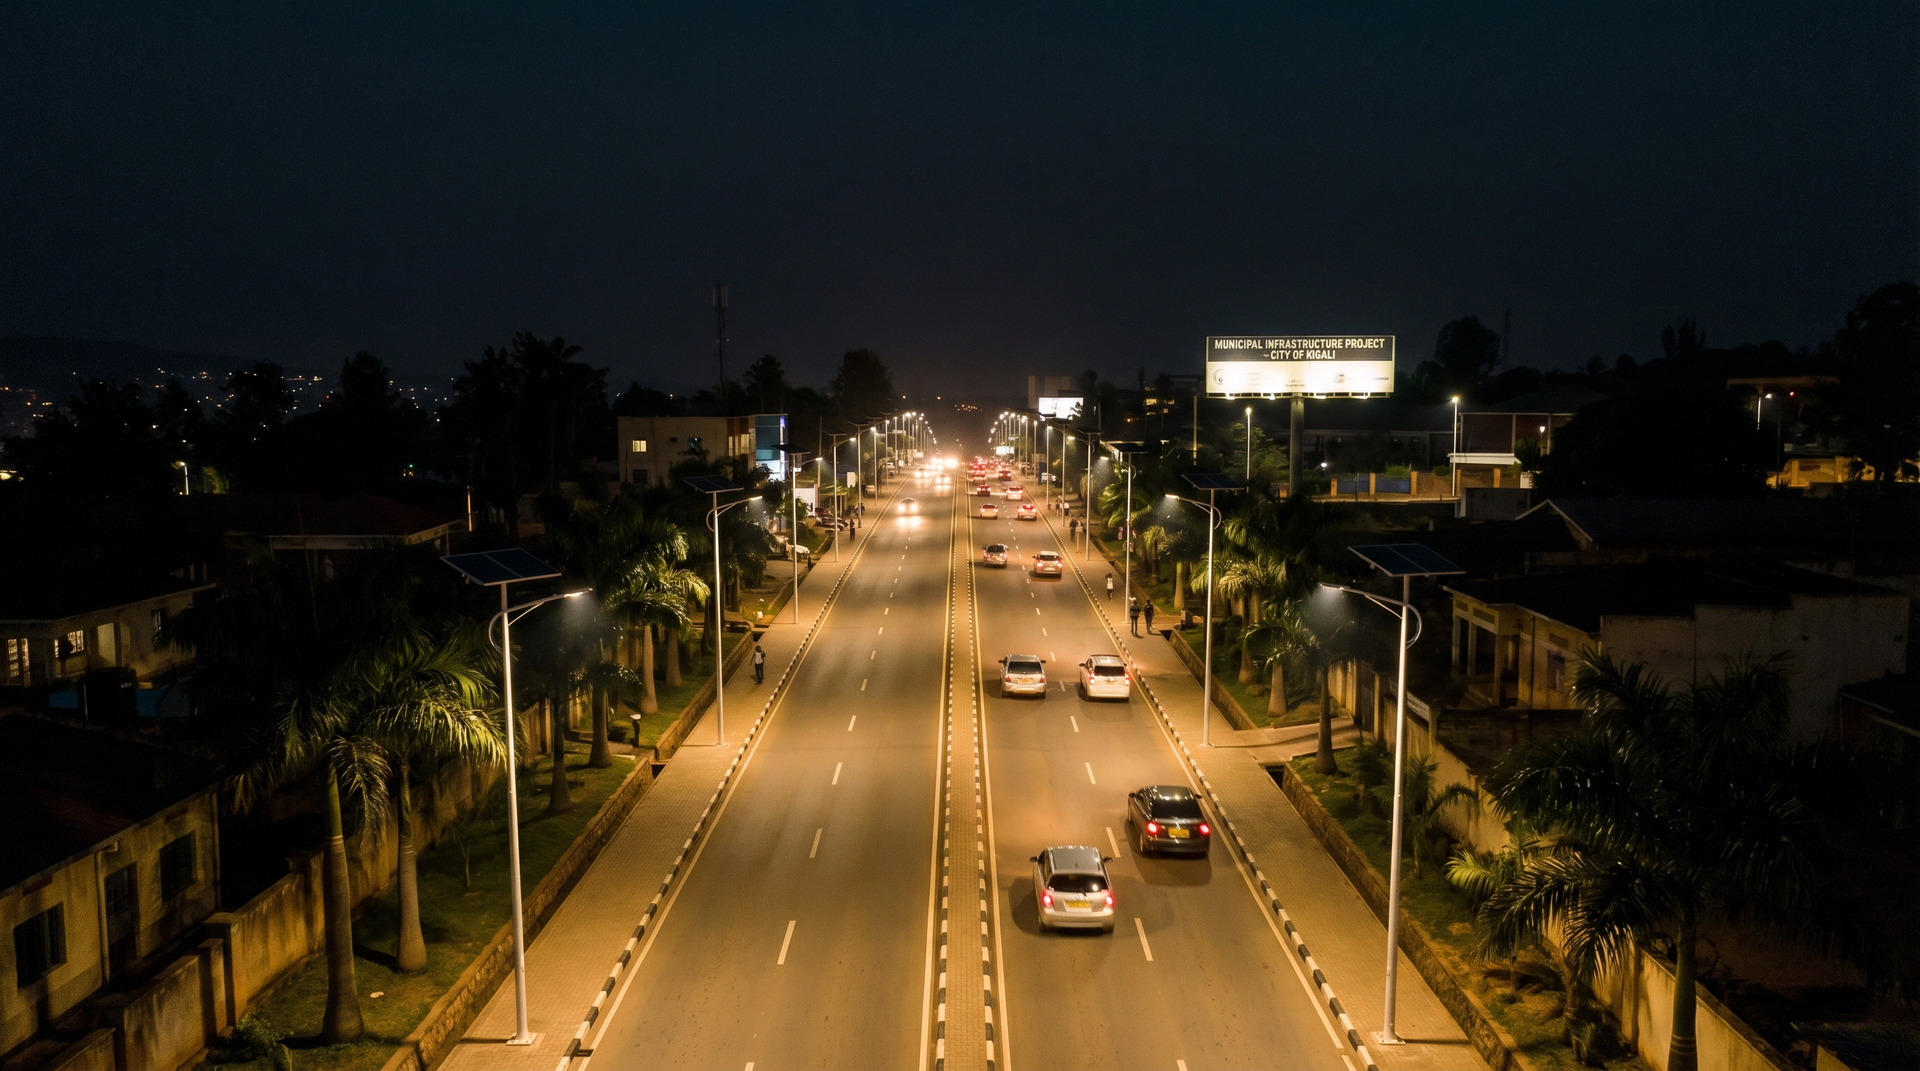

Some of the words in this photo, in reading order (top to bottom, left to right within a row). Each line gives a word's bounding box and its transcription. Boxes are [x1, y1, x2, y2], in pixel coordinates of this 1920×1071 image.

[1214, 339, 1263, 349] MUNICIPAL
[1265, 339, 1343, 349] INFRASTRUCTURE
[1345, 338, 1385, 348] PROJECT
[1270, 350, 1292, 360] CITY
[1293, 350, 1304, 360] OF
[1306, 350, 1336, 360] KIGALI
